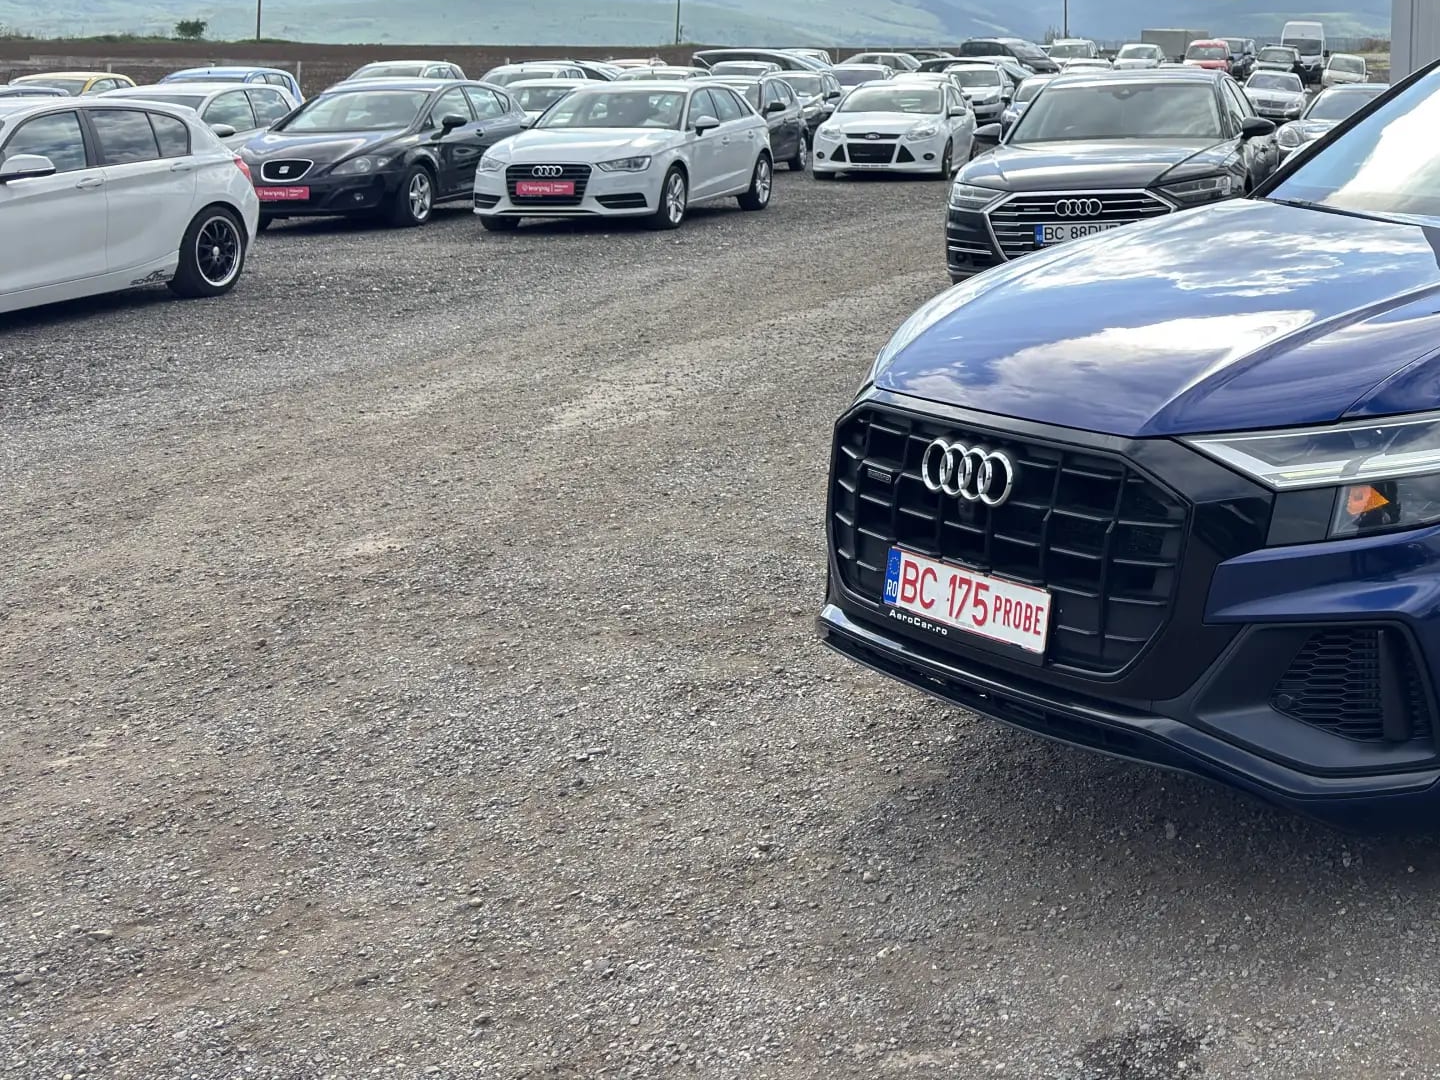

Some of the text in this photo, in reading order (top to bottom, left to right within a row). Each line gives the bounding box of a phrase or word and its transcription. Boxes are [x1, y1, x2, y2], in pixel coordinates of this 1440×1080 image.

[1044, 226, 1064, 240] BC
[886, 579, 898, 598] RO
[900, 559, 1044, 636] BC 175 PROBE
[888, 608, 948, 637] AeroCar.ro
